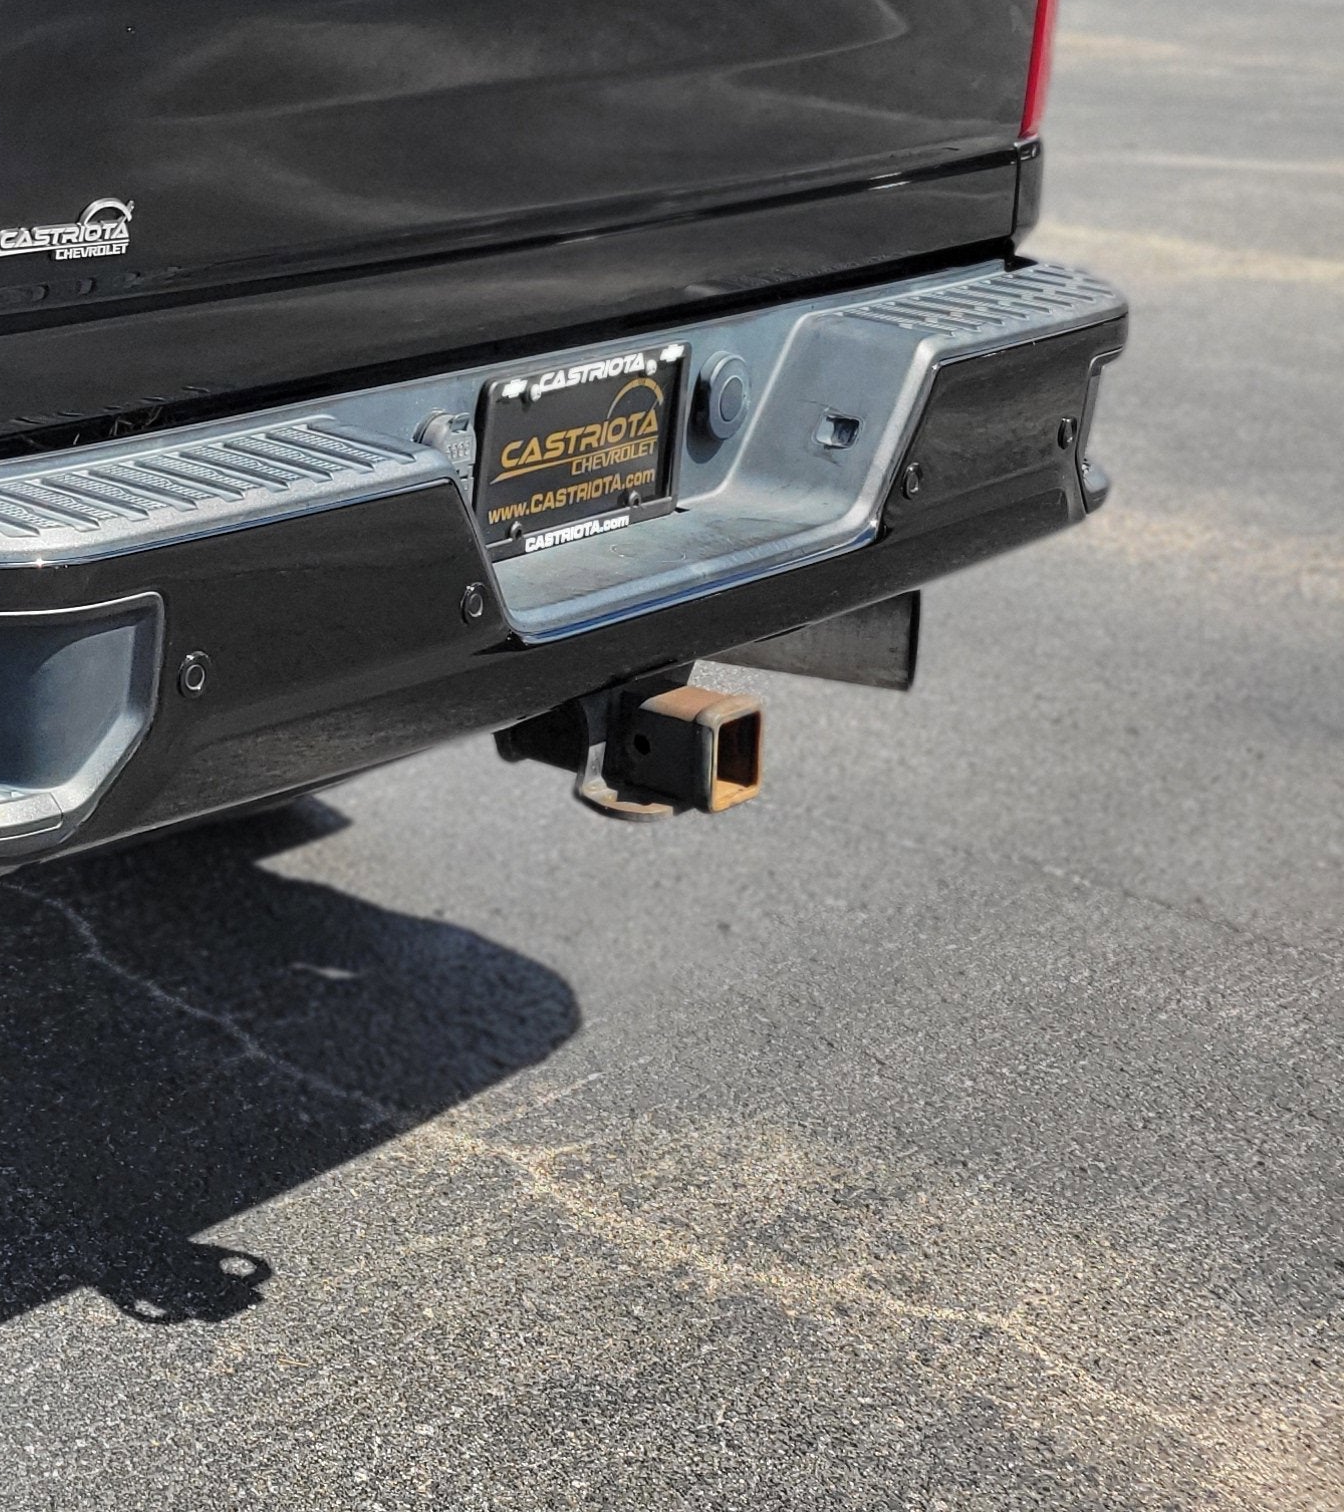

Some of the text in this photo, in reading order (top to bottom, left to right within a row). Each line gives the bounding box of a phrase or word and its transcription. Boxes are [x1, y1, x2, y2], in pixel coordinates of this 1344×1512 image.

[55, 242, 129, 262] CHEVROLET
[539, 352, 645, 394] CASTRIOTA
[500, 408, 659, 469] CASTRIOTA
[570, 440, 657, 477] CHEVROLET
[487, 468, 656, 525] www.CASTRIOTA.com
[524, 514, 630, 553] CASTRIOTA.com
